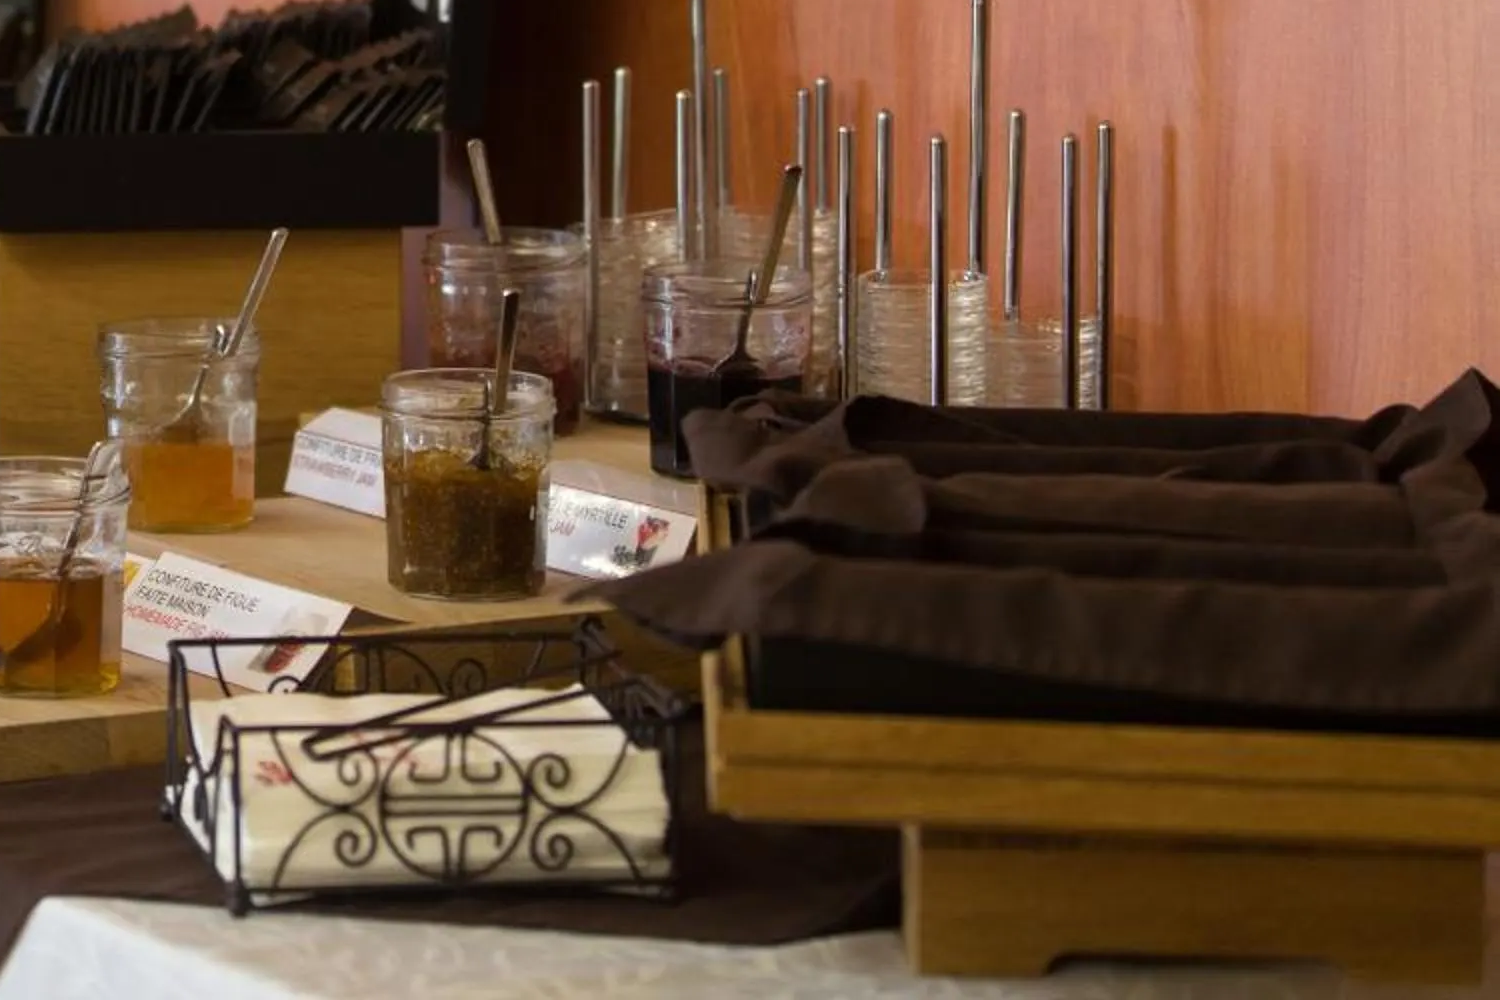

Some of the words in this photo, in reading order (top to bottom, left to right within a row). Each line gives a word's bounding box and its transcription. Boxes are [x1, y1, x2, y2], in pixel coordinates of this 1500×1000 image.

[134, 585, 169, 606] FAITE
[166, 594, 212, 618] MAISON
[147, 569, 209, 597] CONFITURE
[207, 584, 227, 603] DE
[224, 590, 261, 613] FIGUE
[124, 604, 189, 632] HOMEMADE
